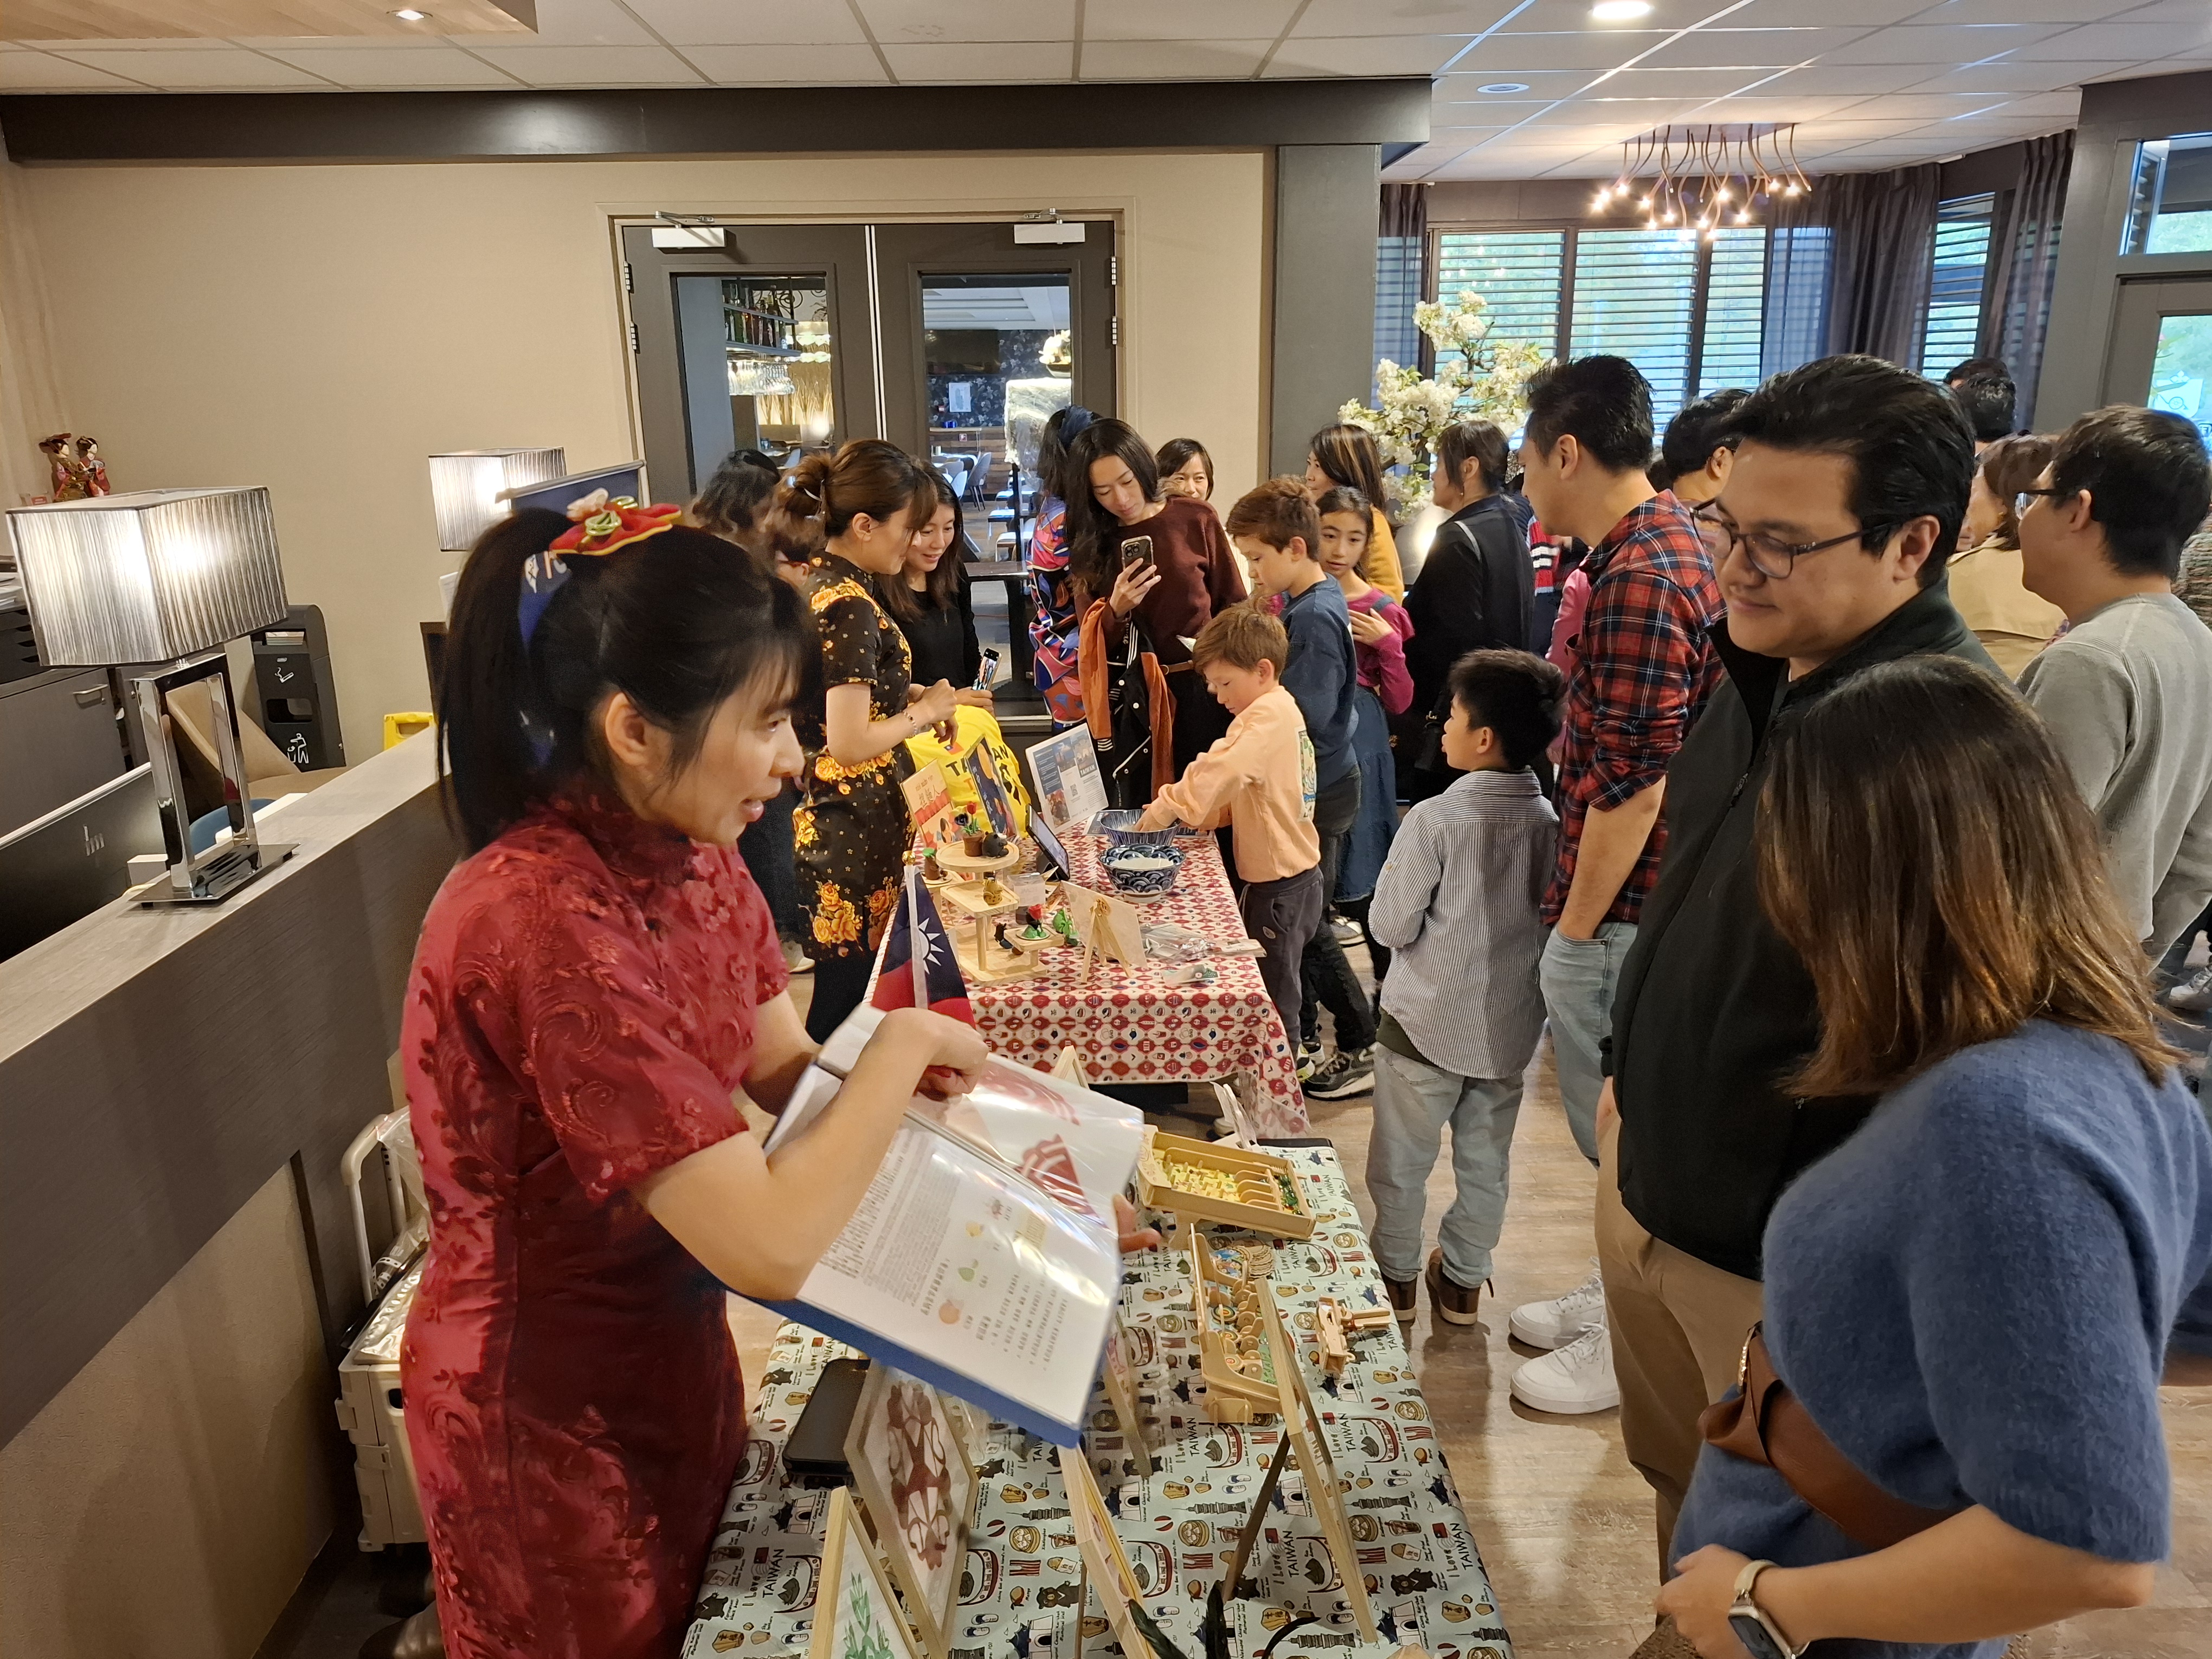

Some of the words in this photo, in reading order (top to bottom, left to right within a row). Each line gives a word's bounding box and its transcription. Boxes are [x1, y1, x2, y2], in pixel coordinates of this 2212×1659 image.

[1081, 765, 1095, 776] TAIWAN
[1323, 1174, 1336, 1195] TAIWAN
[1286, 1239, 1301, 1269] TAIWAN
[1186, 1417, 1200, 1457] TAIWAN
[1330, 1433, 1342, 1453] Love
[1338, 1412, 1356, 1452] TAIWAN
[1175, 1438, 1185, 1457] Love
[1282, 1531, 1300, 1578] TAIWAN
[1450, 1522, 1474, 1570] TAIWAN
[1272, 1553, 1282, 1577] Love
[1443, 1549, 1457, 1572] Love
[762, 1548, 784, 1598] TAIWAN
[744, 1576, 761, 1598] Love
